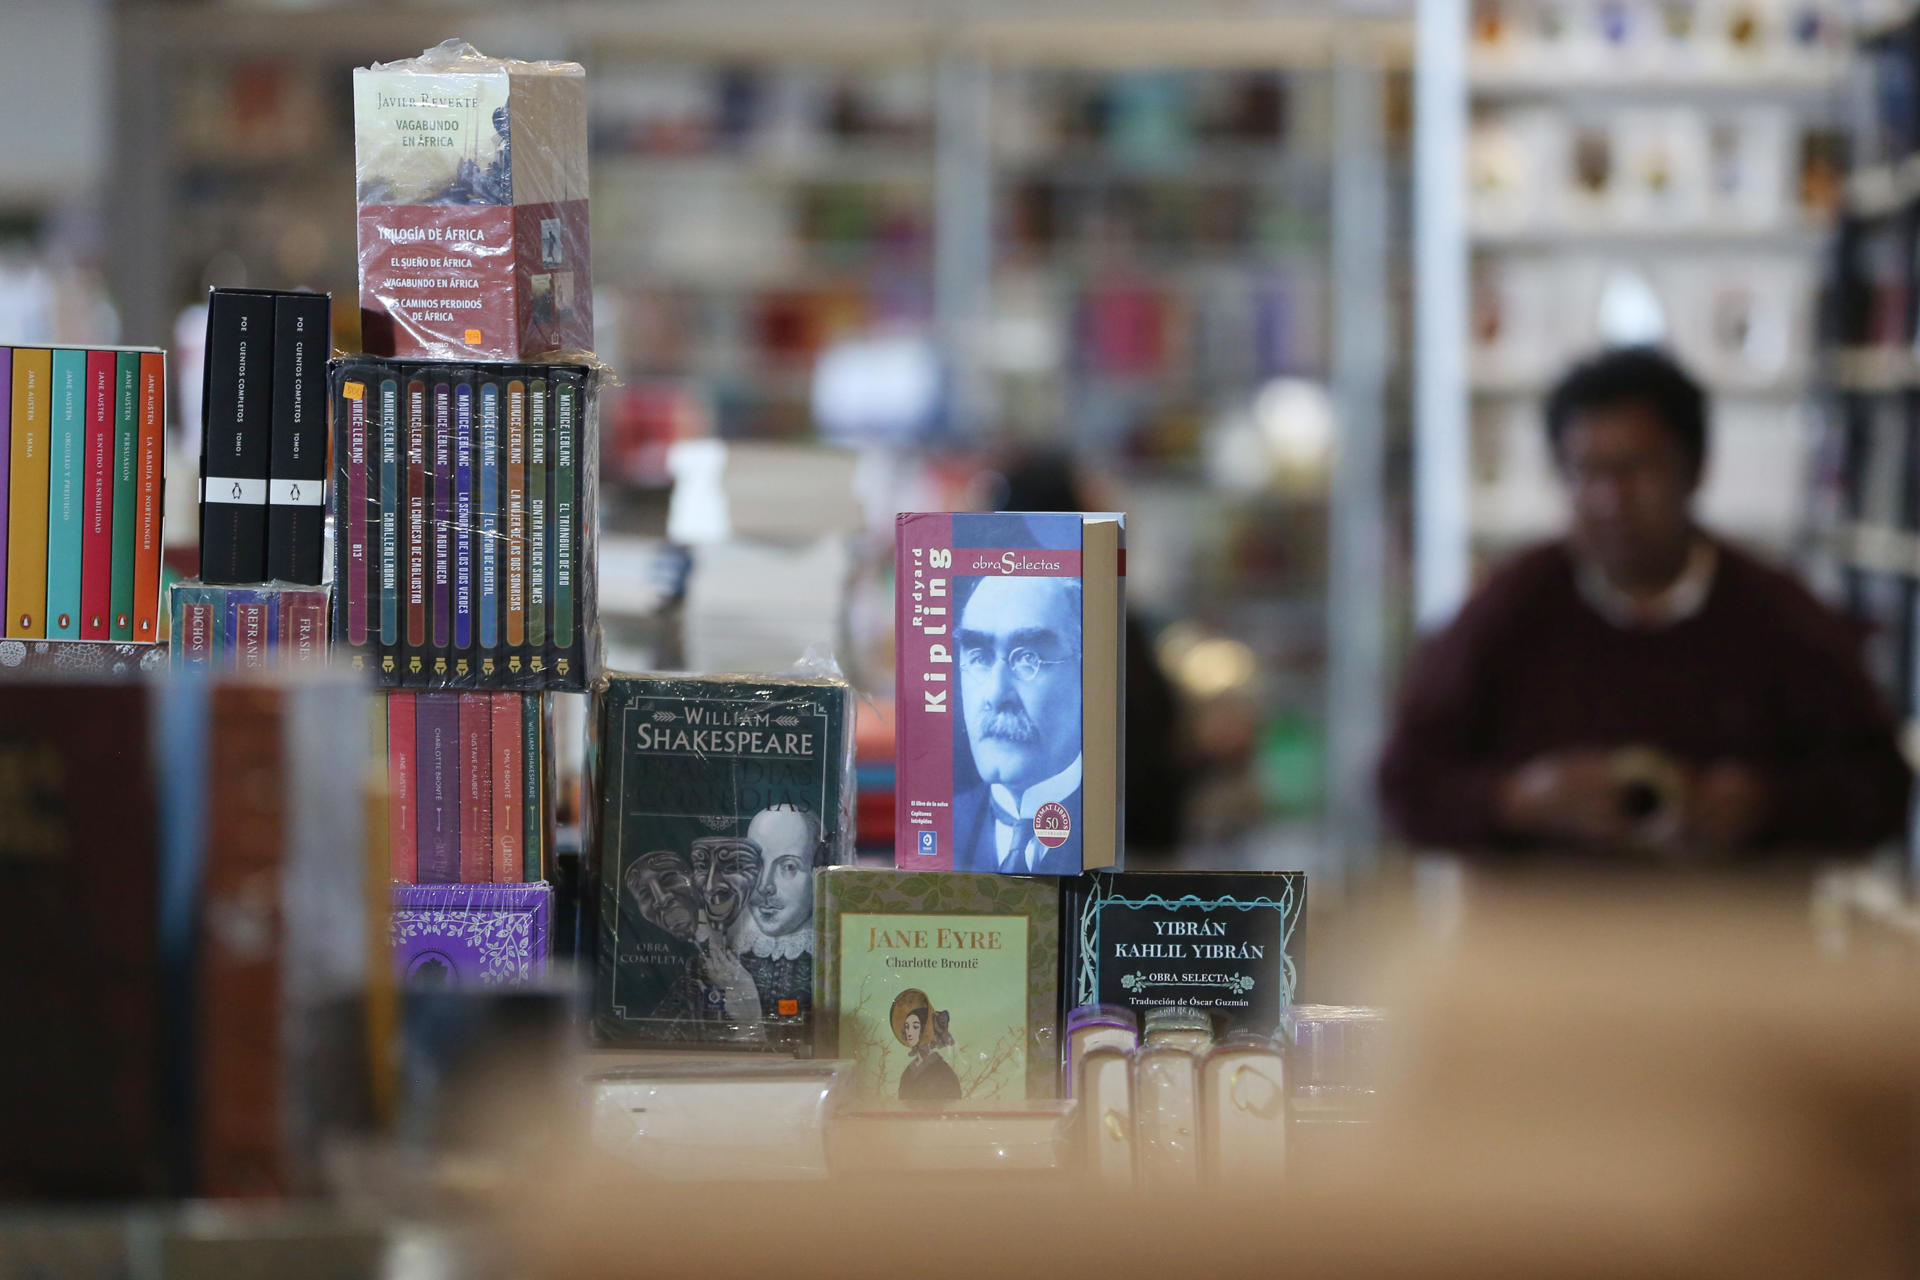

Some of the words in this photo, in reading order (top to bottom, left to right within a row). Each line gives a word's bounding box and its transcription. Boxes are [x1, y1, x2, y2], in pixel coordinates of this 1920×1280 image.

[396, 120, 459, 131] VAGABUNDO
[402, 137, 415, 147] EN
[418, 133, 454, 147] ÁFRICA
[378, 225, 426, 241] TRILOGÍA
[428, 230, 443, 241] DE
[445, 226, 485, 241] ÁFRICA
[391, 258, 400, 267] EL
[401, 256, 429, 268] SUEÑO
[430, 259, 441, 267] DE
[443, 256, 472, 268] ÁFRICA
[386, 278, 435, 288] VAGABUNDO
[437, 280, 448, 288] EN
[450, 278, 479, 289] ÁFRICA
[401, 299, 438, 308] CAMINOS
[440, 299, 482, 309] PERDIDOS
[412, 312, 423, 321] DE
[425, 309, 454, 322] ÁFRICA
[238, 341, 246, 377] CUENTOS
[295, 342, 303, 377] CUENTOS
[27, 370, 35, 389] JANE
[64, 392, 72, 421] AUSTEN
[97, 392, 105, 422] AUSTEN
[124, 391, 132, 421] AUSTEN
[236, 378, 245, 423] COMPLETOS
[294, 379, 302, 423] COMPLETOS
[352, 397, 363, 426] AURICE
[383, 391, 394, 425] MAURICE
[411, 392, 422, 427] MAURICE
[437, 394, 448, 427] MAURICE
[458, 394, 469, 428] MAURICE
[484, 394, 495, 429] MAURICE
[511, 392, 521, 427] MAURICE
[533, 392, 544, 427] MAURICE
[560, 394, 571, 428] MAURICE
[146, 437, 153, 446] LA
[352, 428, 363, 464] LEBLANC
[383, 427, 394, 463] LEBLANC
[411, 429, 422, 464] LEBLANC
[437, 430, 448, 465] LEBLANC
[458, 431, 469, 467] LEBLANC
[484, 431, 495, 466] LEBLANC
[511, 429, 521, 464] LEBLANC
[533, 429, 544, 464] LEBLANC
[560, 431, 571, 467] LEBLANC
[123, 432, 131, 481] PERSUASIÓN
[146, 450, 154, 479] ABADÍA
[145, 482, 152, 492] DE
[458, 492, 468, 502] LA
[510, 489, 521, 499] LA
[95, 478, 103, 534] SENSIBILIDAD
[411, 497, 422, 508] LA
[510, 501, 521, 527] MUJER
[532, 499, 543, 529] CONTRA
[559, 503, 569, 513] EL
[144, 495, 152, 550] NORTHANGER
[383, 512, 394, 556] CABALLERO
[411, 509, 422, 544] CONDESA
[436, 522, 447, 533] LA
[483, 518, 494, 527] EL
[510, 529, 521, 539] DE
[411, 546, 422, 556] DE
[436, 534, 447, 558] AGUJA
[458, 541, 468, 551] DE
[483, 529, 494, 554] APON
[510, 540, 521, 554] LAS
[532, 532, 543, 566] HERLOCK
[436, 560, 447, 584] HUECA
[458, 552, 468, 565] LOS
[483, 555, 494, 565] DE
[510, 557, 521, 572] DOS
[559, 560, 569, 569] DE
[972, 552, 1060, 574] obraSelectas
[411, 558, 422, 604] CAGLIOSTRO
[458, 567, 468, 585] OJOS
[483, 566, 494, 596] CRISTAL
[532, 568, 543, 604] SHOLMES
[559, 571, 569, 586] ORO
[912, 548, 924, 626] Rudyard
[458, 586, 468, 614] VERDES
[510, 573, 521, 611] SONRISAS
[192, 607, 204, 650] DICHOS
[247, 607, 259, 668] REFRANES
[300, 618, 311, 662] FRASES
[923, 548, 952, 712] Kipling
[684, 706, 769, 727] WILLIAM
[637, 723, 813, 755] SHAKESPEARE
[1035, 804, 1052, 829] EDIMAT
[1053, 804, 1069, 830] LIBROS
[1045, 817, 1059, 830] 50
[867, 928, 928, 952] JANE
[936, 928, 1002, 949] EYRE
[1153, 918, 1227, 936] YIBRÁN
[620, 954, 685, 966] COMPLETA
[636, 943, 669, 953] OBRA
[1115, 943, 1187, 957] KAHLIL
[1190, 941, 1265, 959] YIBRÁN
[886, 957, 938, 968] Charlotte
[941, 958, 979, 968] Brontë
[1149, 973, 1178, 982] OBRA
[1182, 973, 1229, 983] SELECTA
[1129, 997, 1176, 1006] Traducción
[1178, 997, 1188, 1006] de
[1190, 997, 1212, 1007] Óscar
[1215, 999, 1249, 1007] Guzmán
